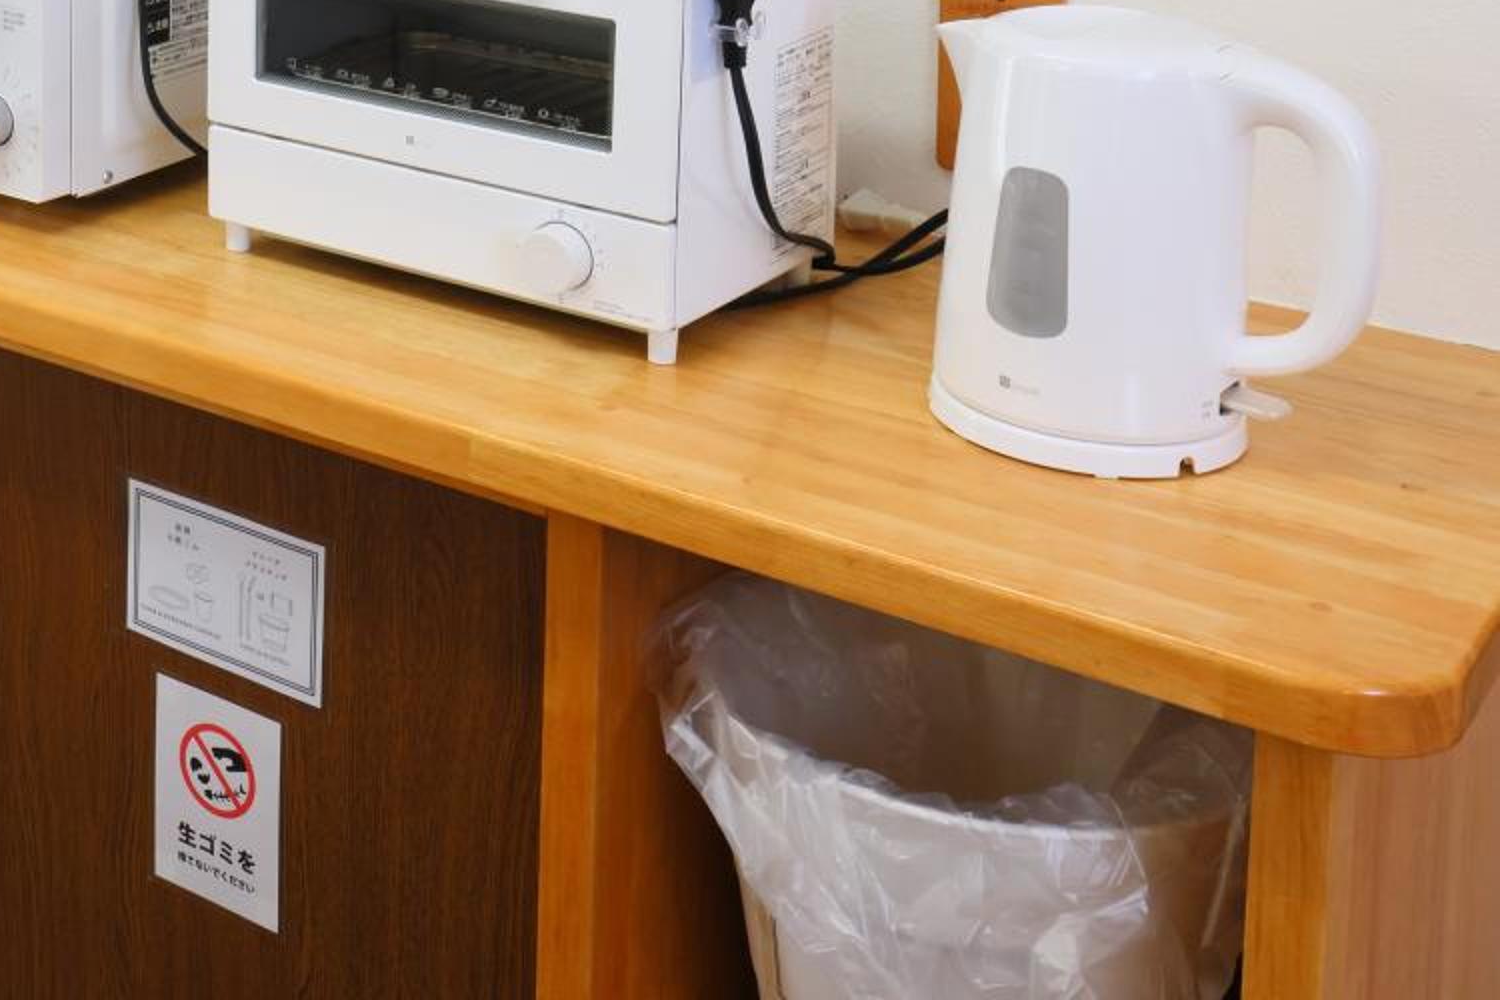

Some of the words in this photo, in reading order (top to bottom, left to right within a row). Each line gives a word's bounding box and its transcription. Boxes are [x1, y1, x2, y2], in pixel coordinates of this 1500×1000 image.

[177, 850, 255, 893] 捨てないでください
[178, 821, 256, 875] 生ゴミを
